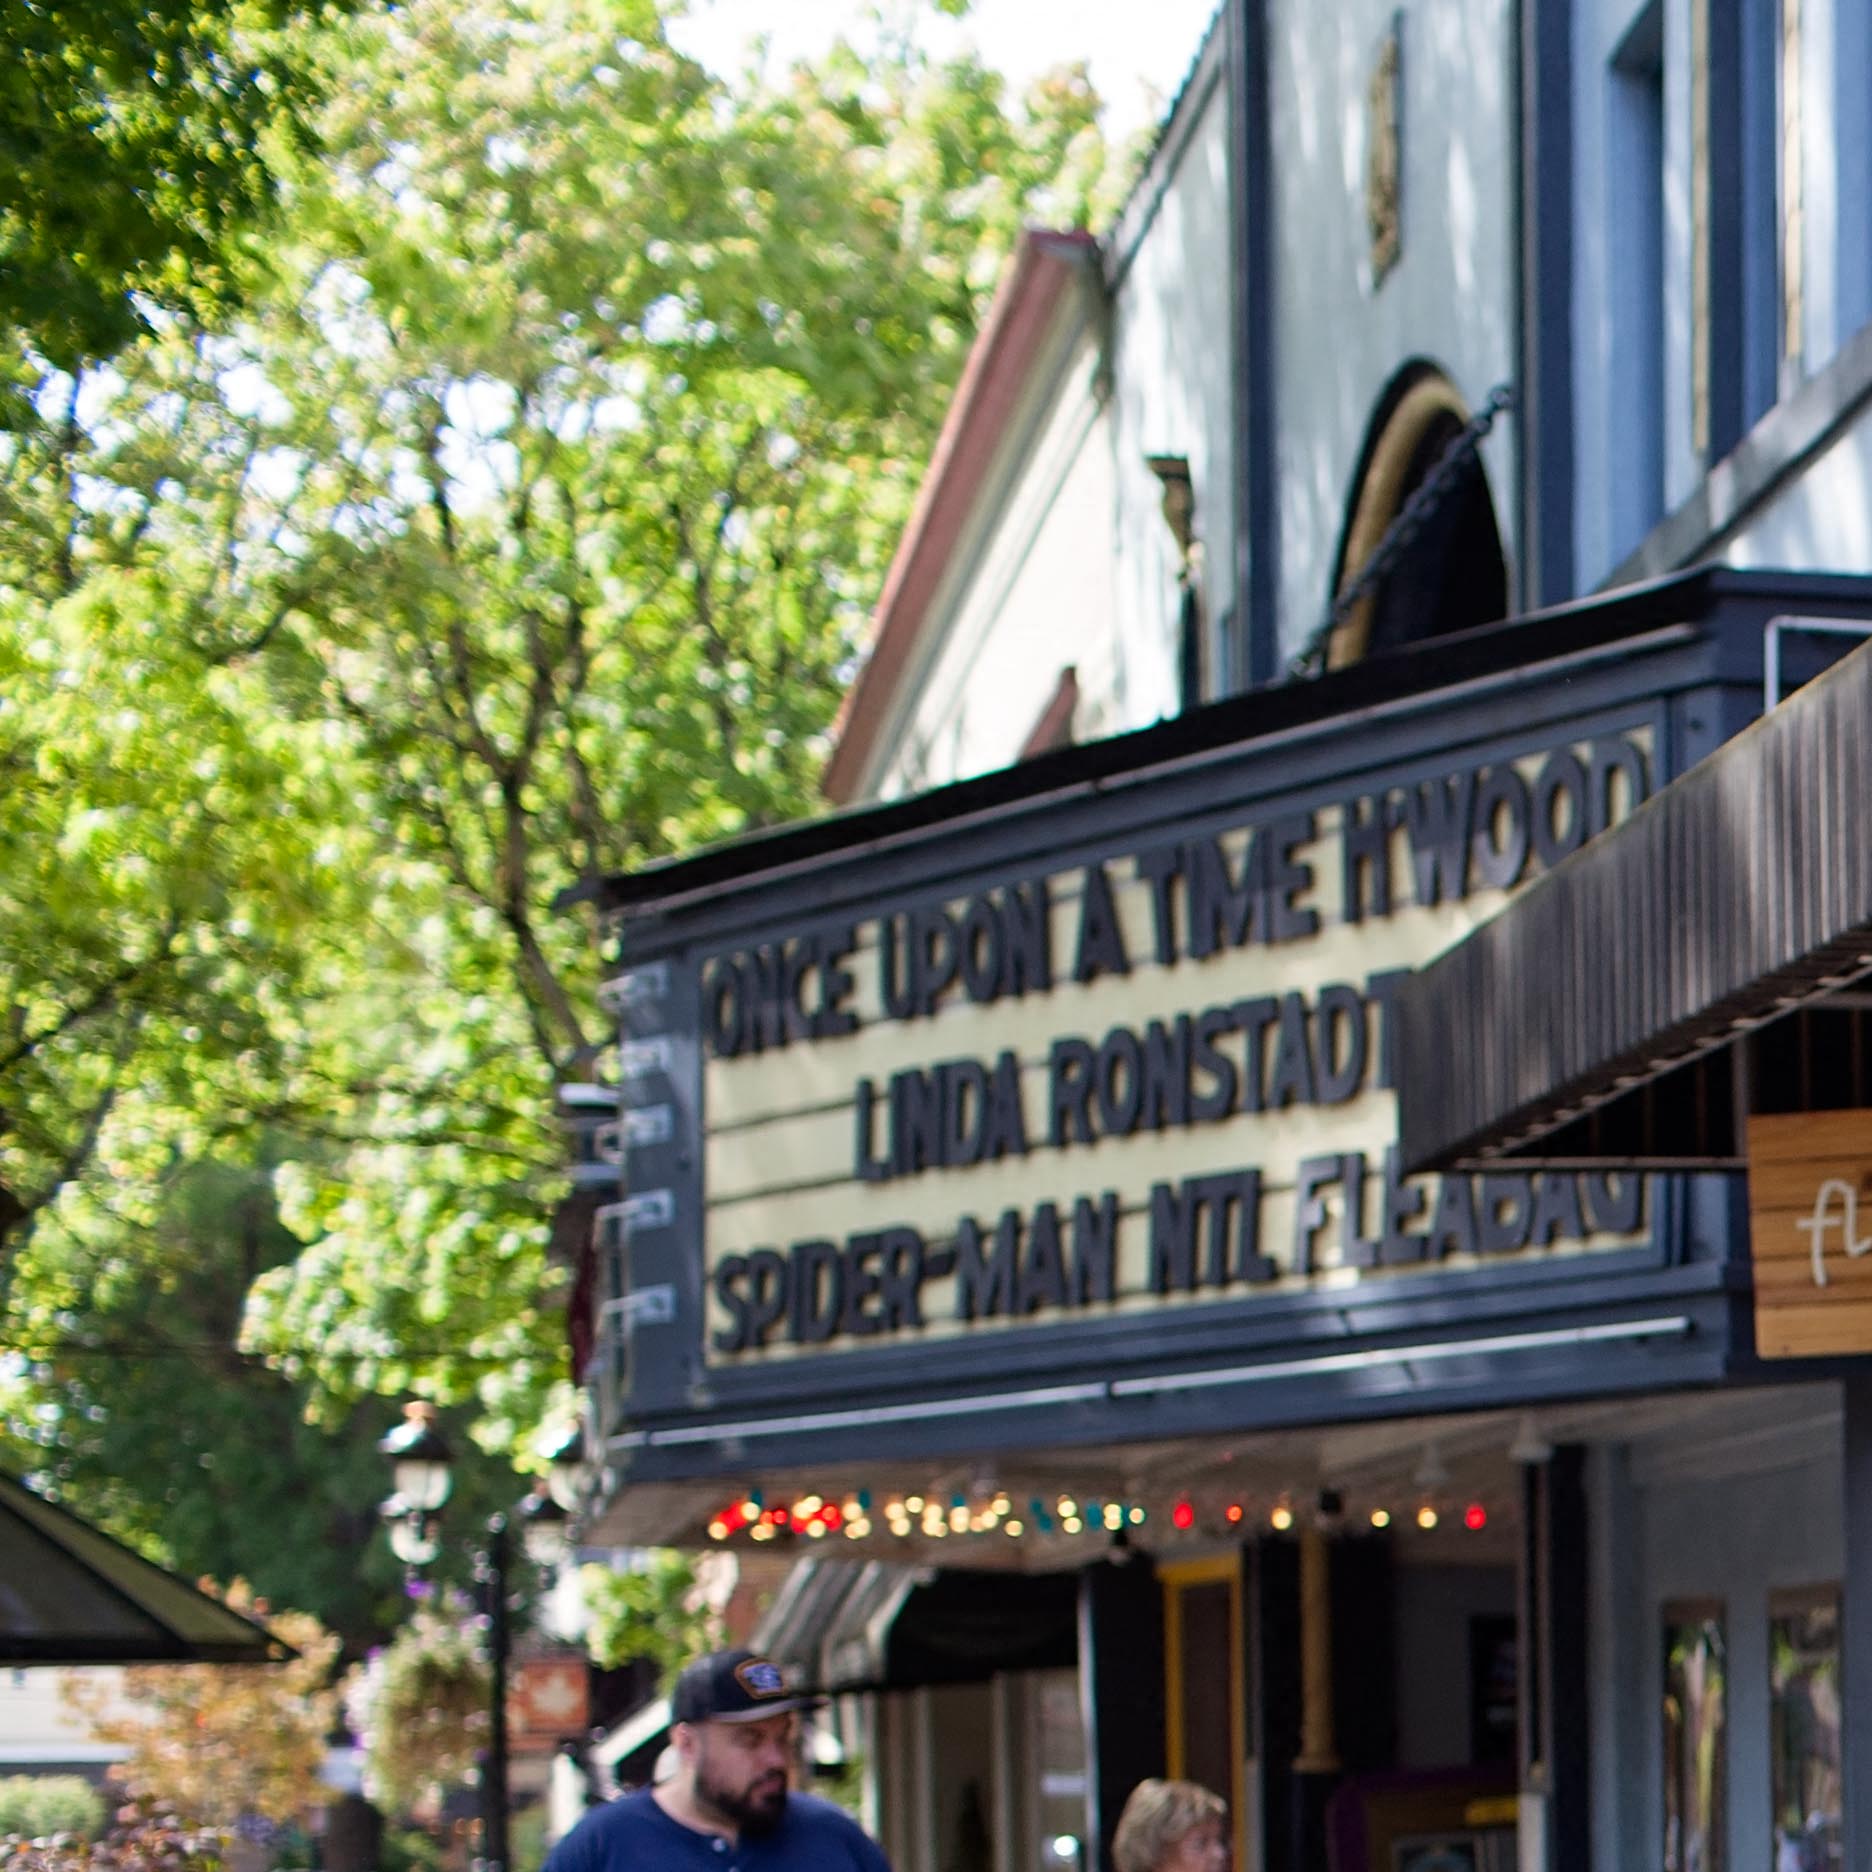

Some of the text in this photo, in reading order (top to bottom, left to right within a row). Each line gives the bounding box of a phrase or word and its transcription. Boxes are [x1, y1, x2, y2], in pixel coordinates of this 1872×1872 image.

[708, 922, 860, 1058] ONCE
[878, 872, 1052, 1024] UPON
[1073, 862, 1132, 985] A
[1135, 815, 1322, 968] TIME
[854, 1050, 1033, 1184] LINDA
[712, 1190, 1120, 1354] SPIDER-MAN
